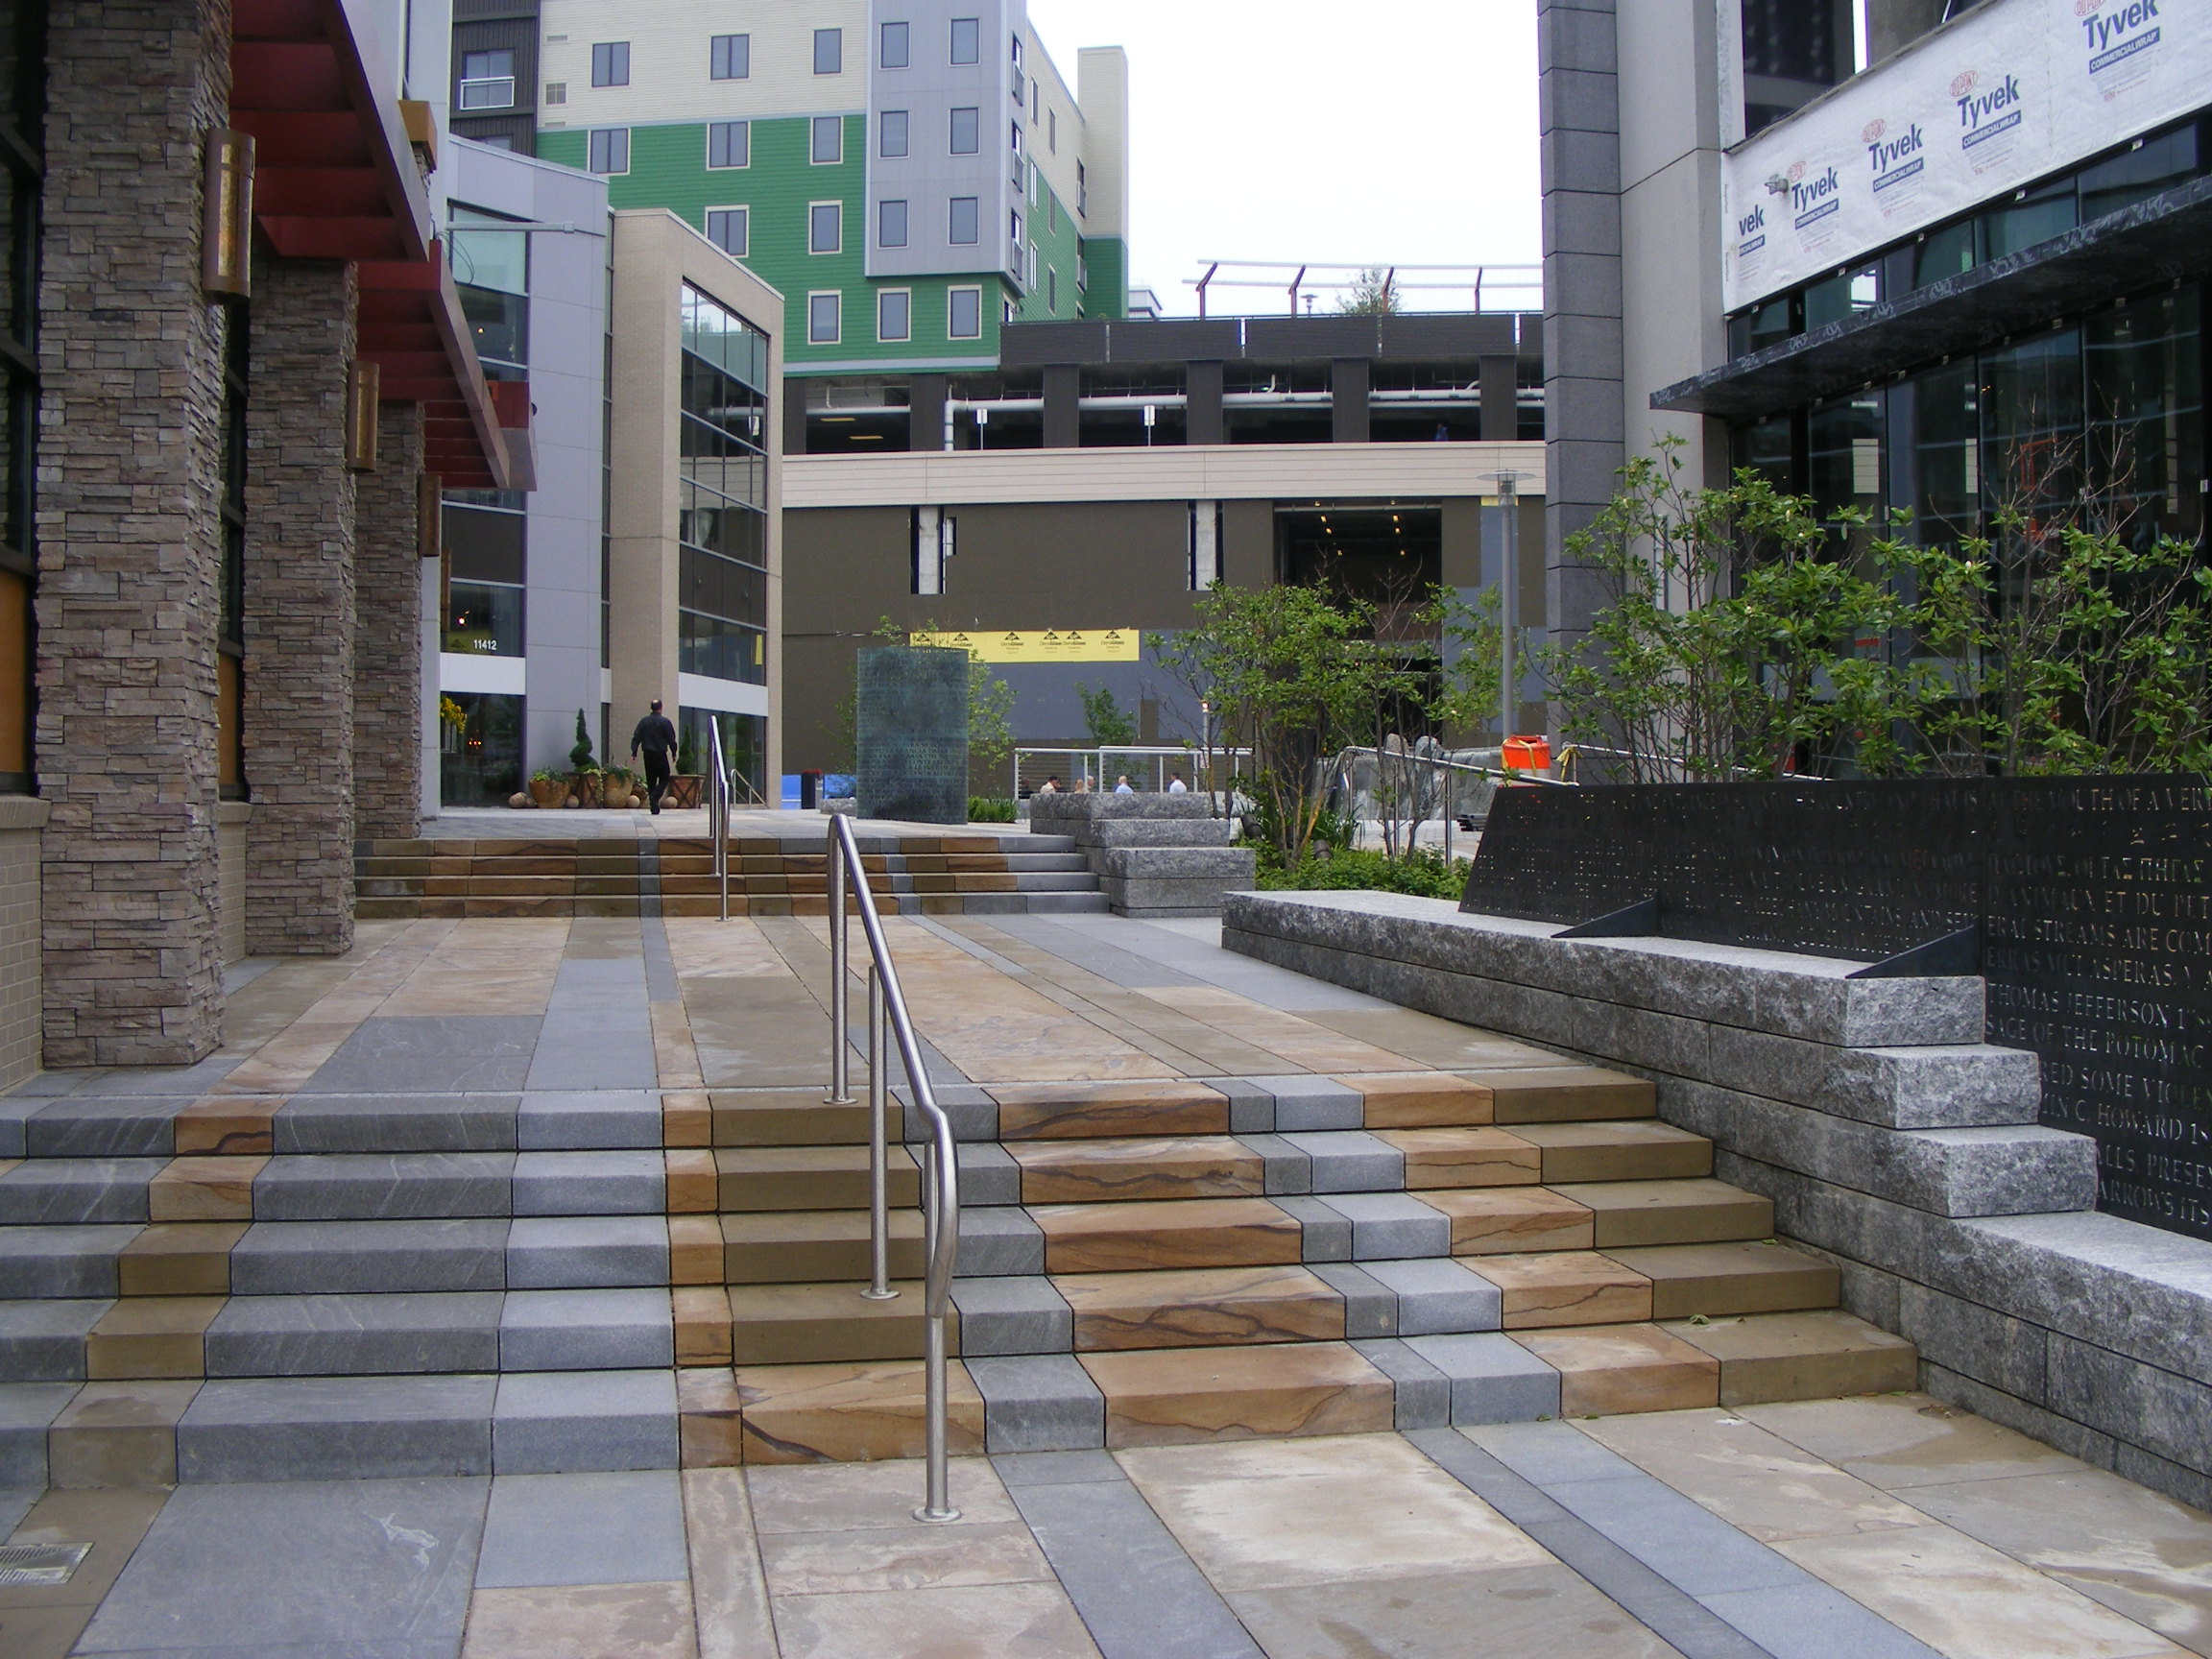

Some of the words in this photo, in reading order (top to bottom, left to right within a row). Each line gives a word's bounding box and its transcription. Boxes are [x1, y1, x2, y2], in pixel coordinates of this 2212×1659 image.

[2082, 0, 2159, 51] Tyvek
[1958, 74, 2020, 129] Tyvek
[1868, 123, 1922, 173] Tyvek
[1791, 166, 1838, 212] Tyvek
[1739, 204, 1764, 236] vek
[473, 638, 497, 650] 11412
[1986, 981, 2060, 1013] THOMAS
[2067, 991, 2170, 1029] JEFFERSON
[2062, 1025, 2099, 1051] THE
[2104, 1031, 2204, 1069] POTOMAC
[2080, 1067, 2133, 1097] SOME
[2097, 1102, 2183, 1141] HOWARD
